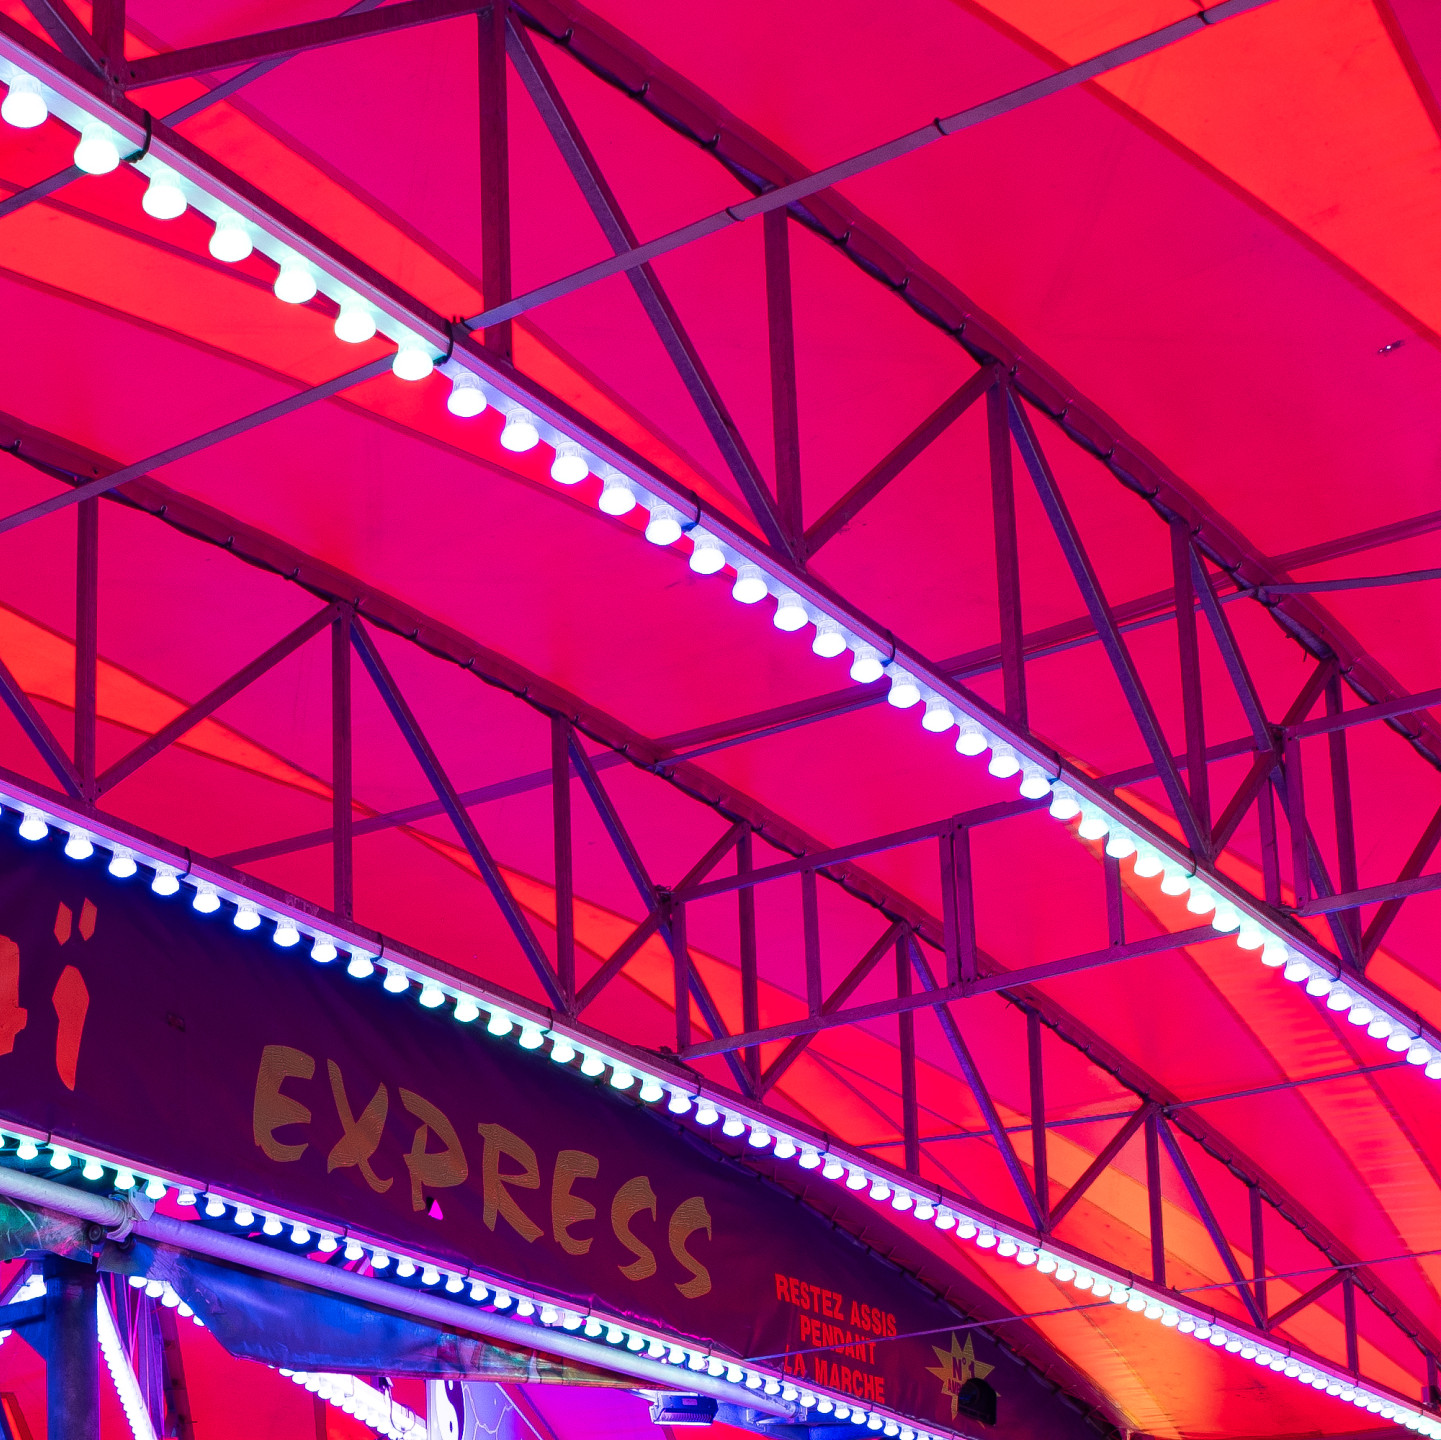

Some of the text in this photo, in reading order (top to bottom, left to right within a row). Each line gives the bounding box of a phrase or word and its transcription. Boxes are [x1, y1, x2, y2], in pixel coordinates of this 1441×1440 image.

[252, 1044, 713, 1300] EXPRESS
[774, 1272, 897, 1338] RESTEZ ASSIS
[784, 1343, 806, 1378] LA
[800, 1314, 877, 1366] PENDANT
[815, 1356, 886, 1404] MARCHE
